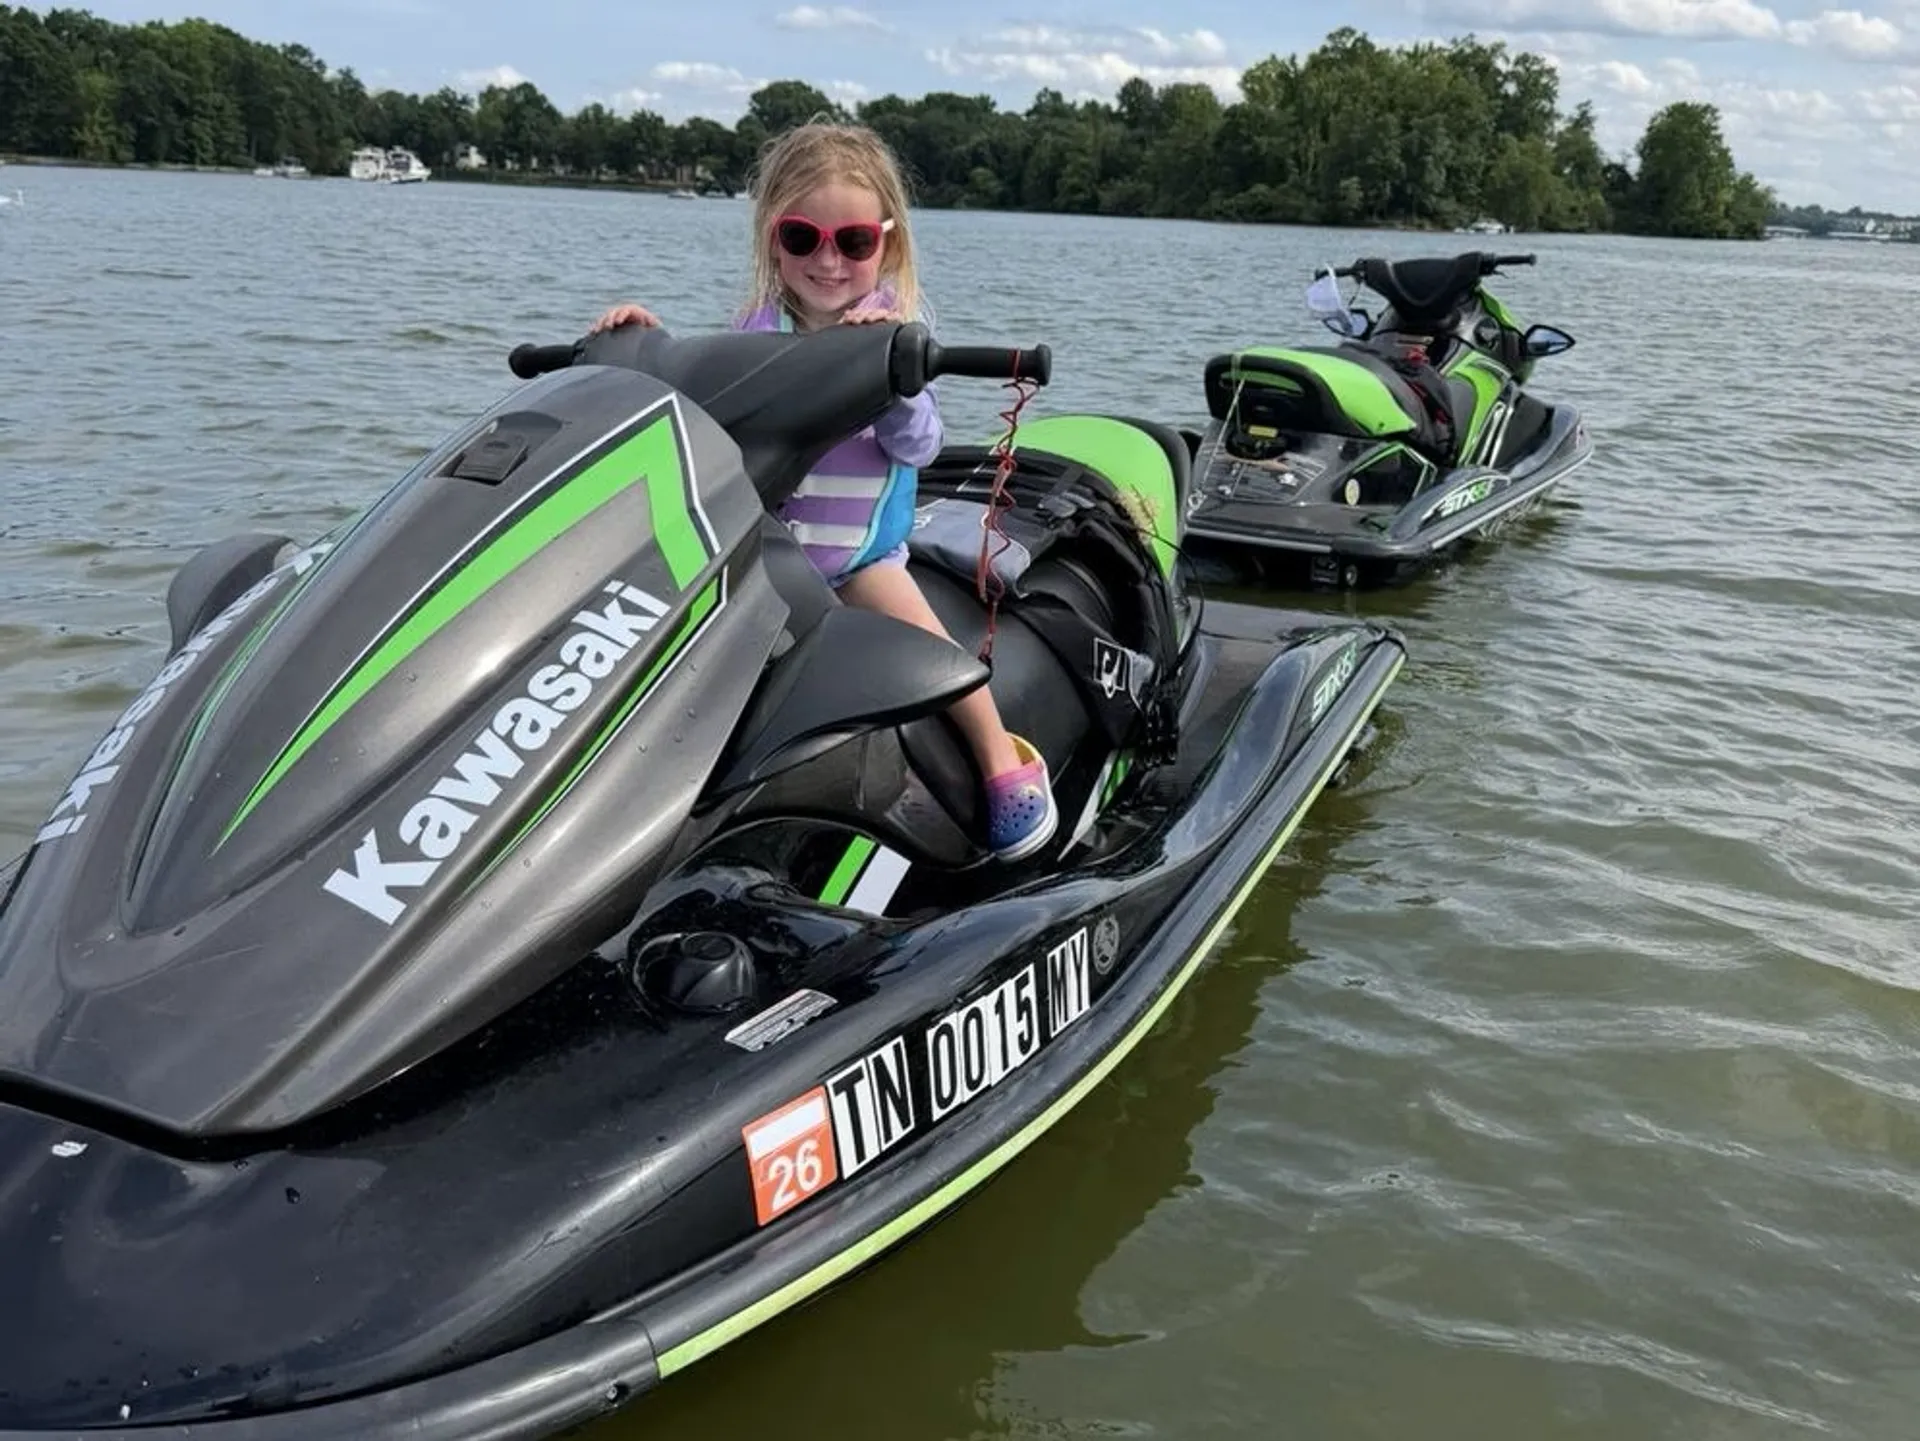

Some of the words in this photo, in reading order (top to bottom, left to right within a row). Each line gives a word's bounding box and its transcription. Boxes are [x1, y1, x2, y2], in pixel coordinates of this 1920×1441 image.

[322, 580, 671, 925] Kawasaki
[832, 1038, 913, 1168] TN
[931, 974, 1036, 1111] 0015
[1049, 930, 1086, 1034] MY
[768, 1139, 823, 1212] 26
